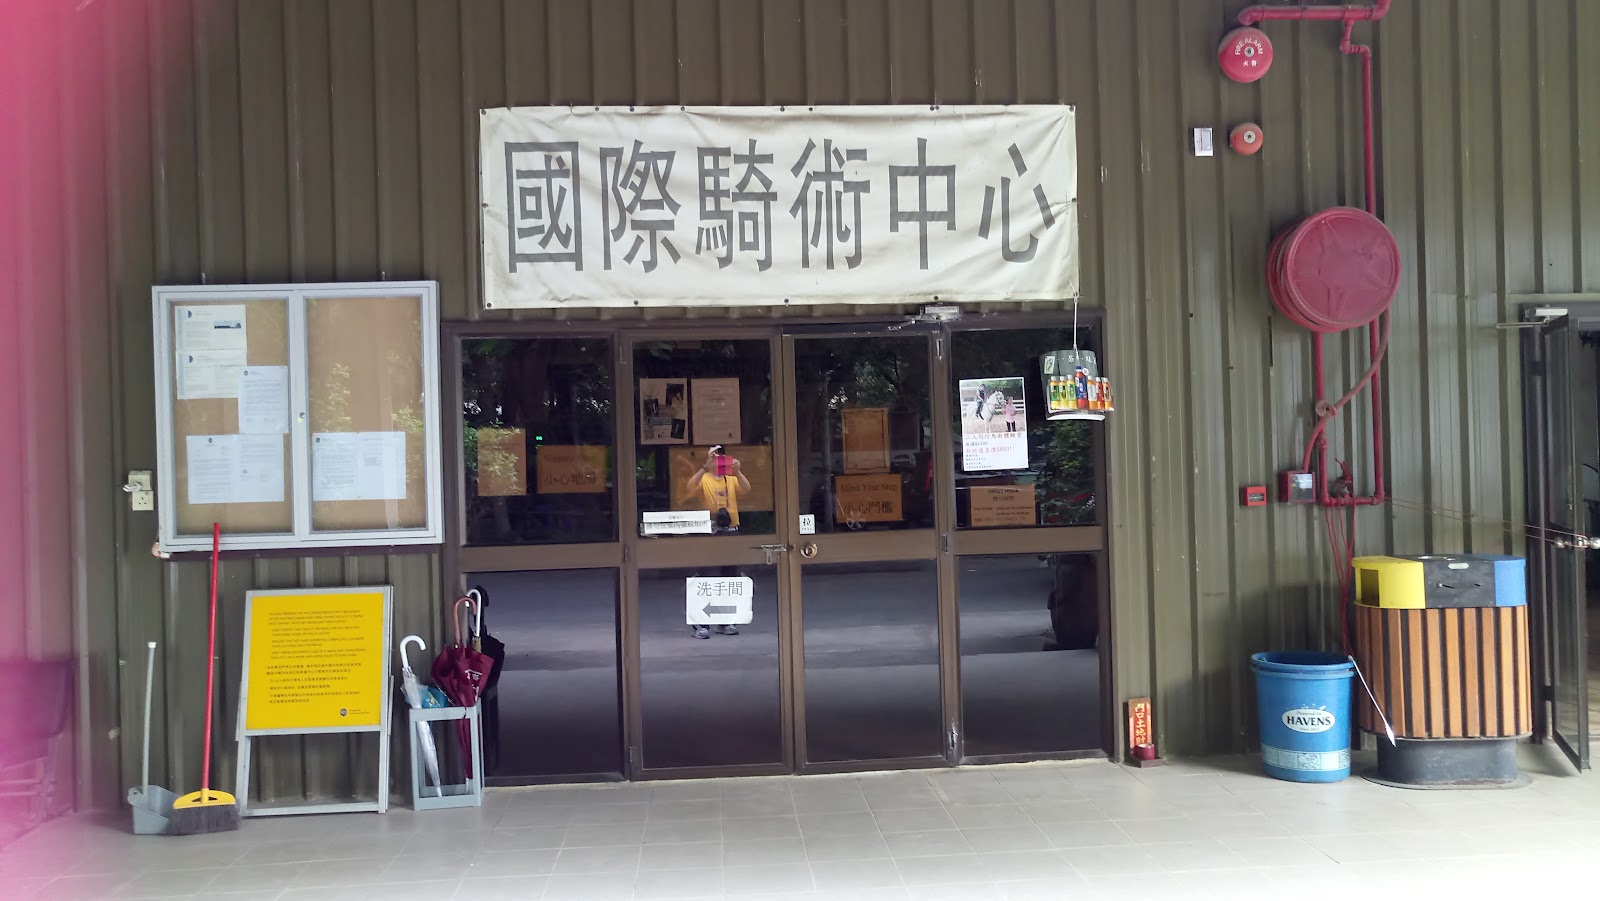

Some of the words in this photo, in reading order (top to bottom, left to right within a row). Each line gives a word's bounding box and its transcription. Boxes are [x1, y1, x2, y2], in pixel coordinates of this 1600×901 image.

[1235, 41, 1245, 55] FIRE
[1245, 38, 1264, 54] ALARM
[504, 137, 1056, 273] 國際騎術中心
[882, 483, 898, 492] Step
[697, 581, 743, 596] 洗手間
[1286, 715, 1331, 726] HAVENS
